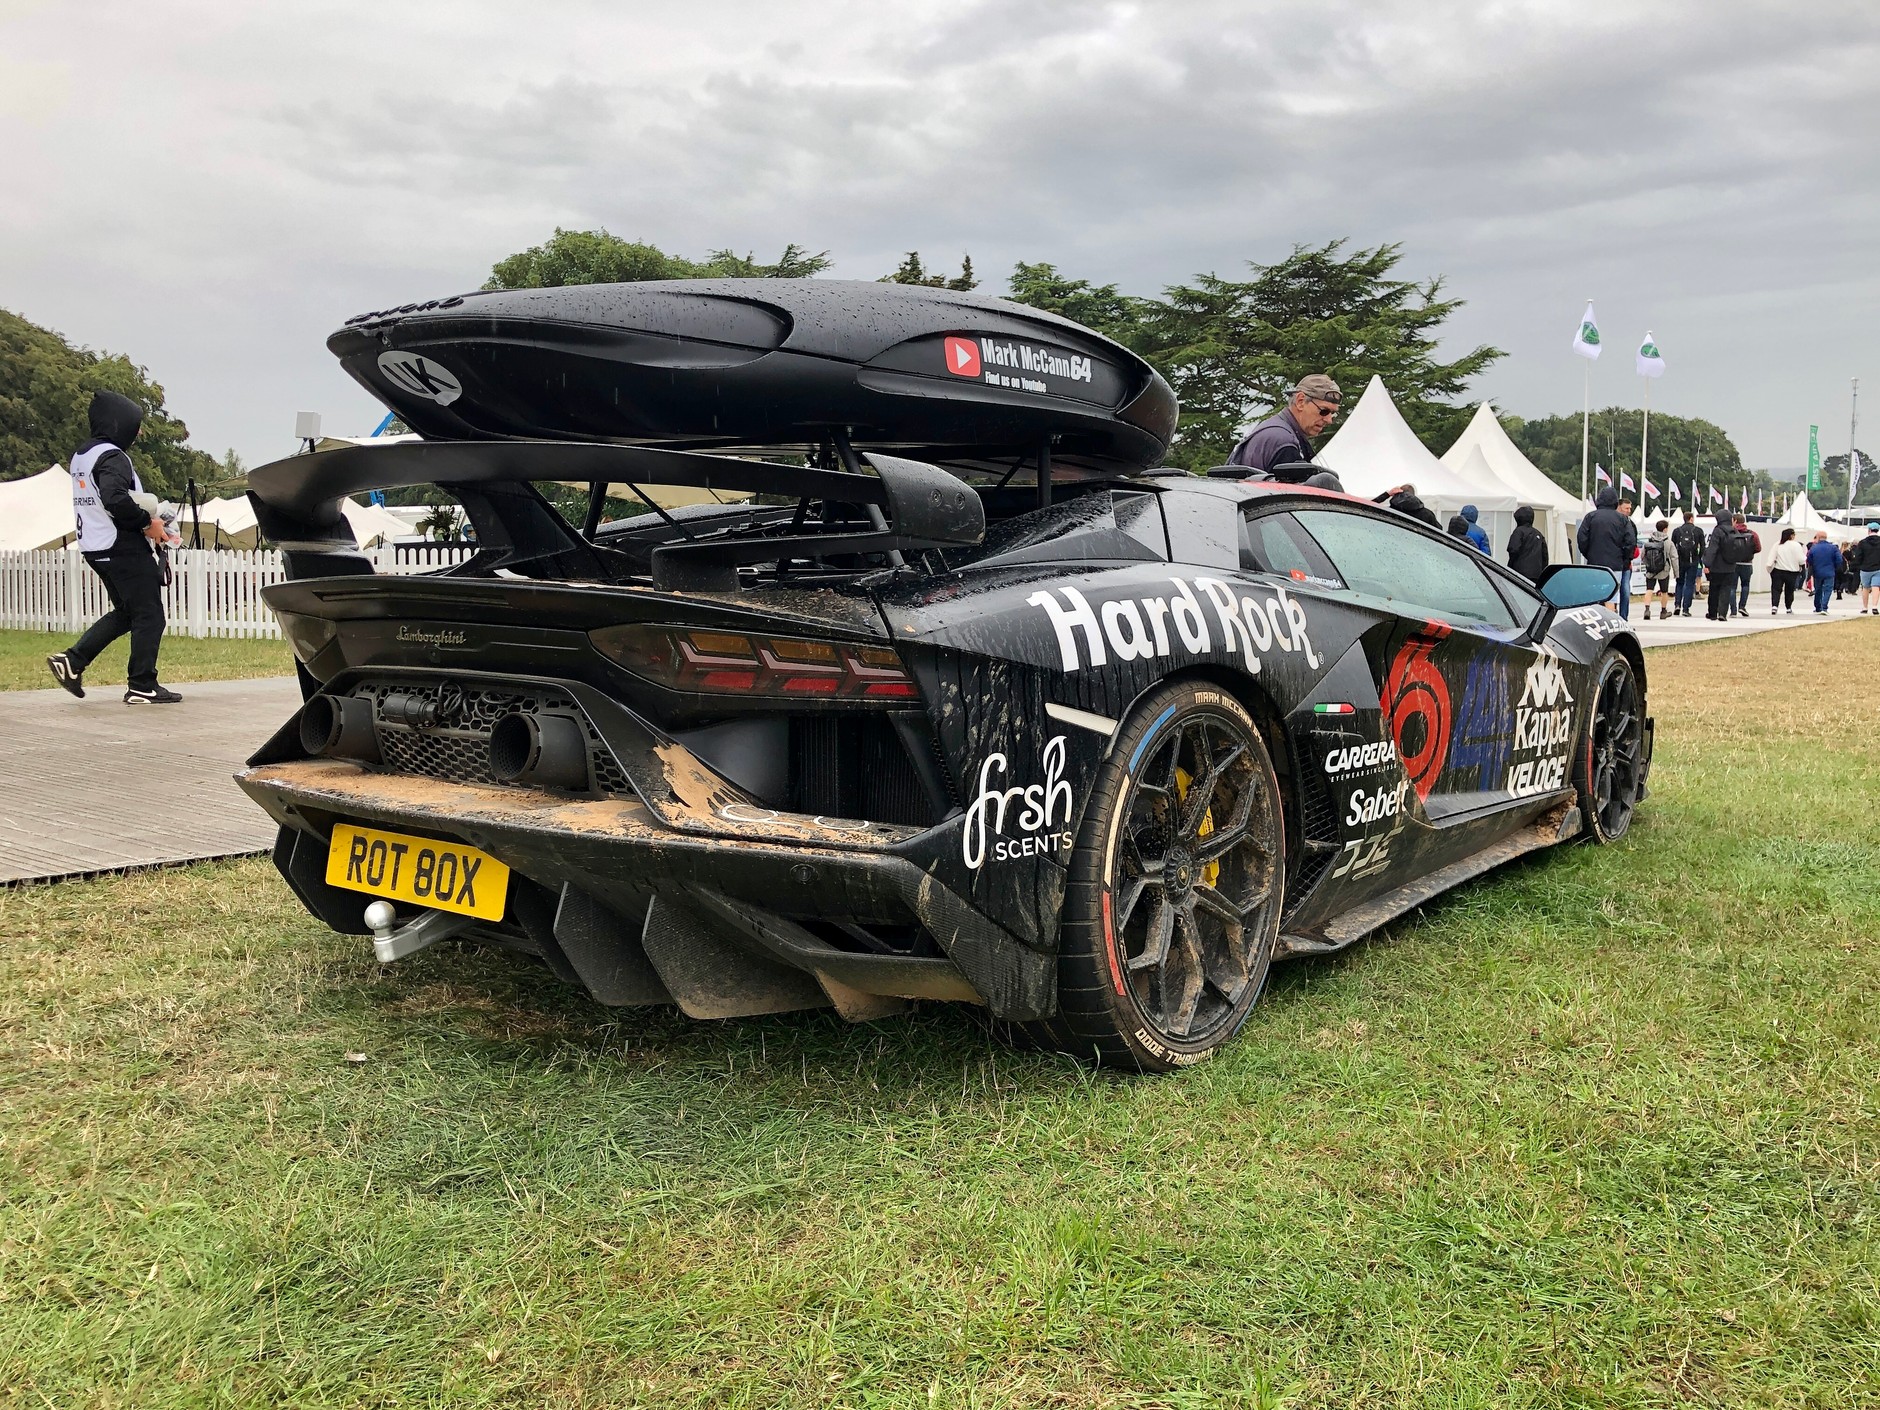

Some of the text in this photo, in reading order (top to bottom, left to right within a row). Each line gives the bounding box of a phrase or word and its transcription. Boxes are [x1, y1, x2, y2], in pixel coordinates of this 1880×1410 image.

[381, 357, 458, 396] UK
[981, 337, 1092, 383] Mark McCann64
[985, 371, 1001, 386] Find
[1001, 376, 1010, 387] us
[1011, 378, 1021, 389] on
[396, 625, 467, 646] Lamborghini
[1025, 576, 1320, 674] Hard Rock
[1194, 691, 1220, 704] MARK
[1513, 706, 1571, 757] Kappa
[1324, 740, 1396, 773] CARRERA
[1330, 770, 1365, 783] EYEWEAR
[1366, 765, 1384, 776] SINC
[1507, 755, 1568, 799] VELOCE
[963, 735, 1073, 869] frsh
[1346, 779, 1411, 827] Sabelt
[346, 834, 409, 891] ROT
[996, 830, 1073, 862] SCENTS
